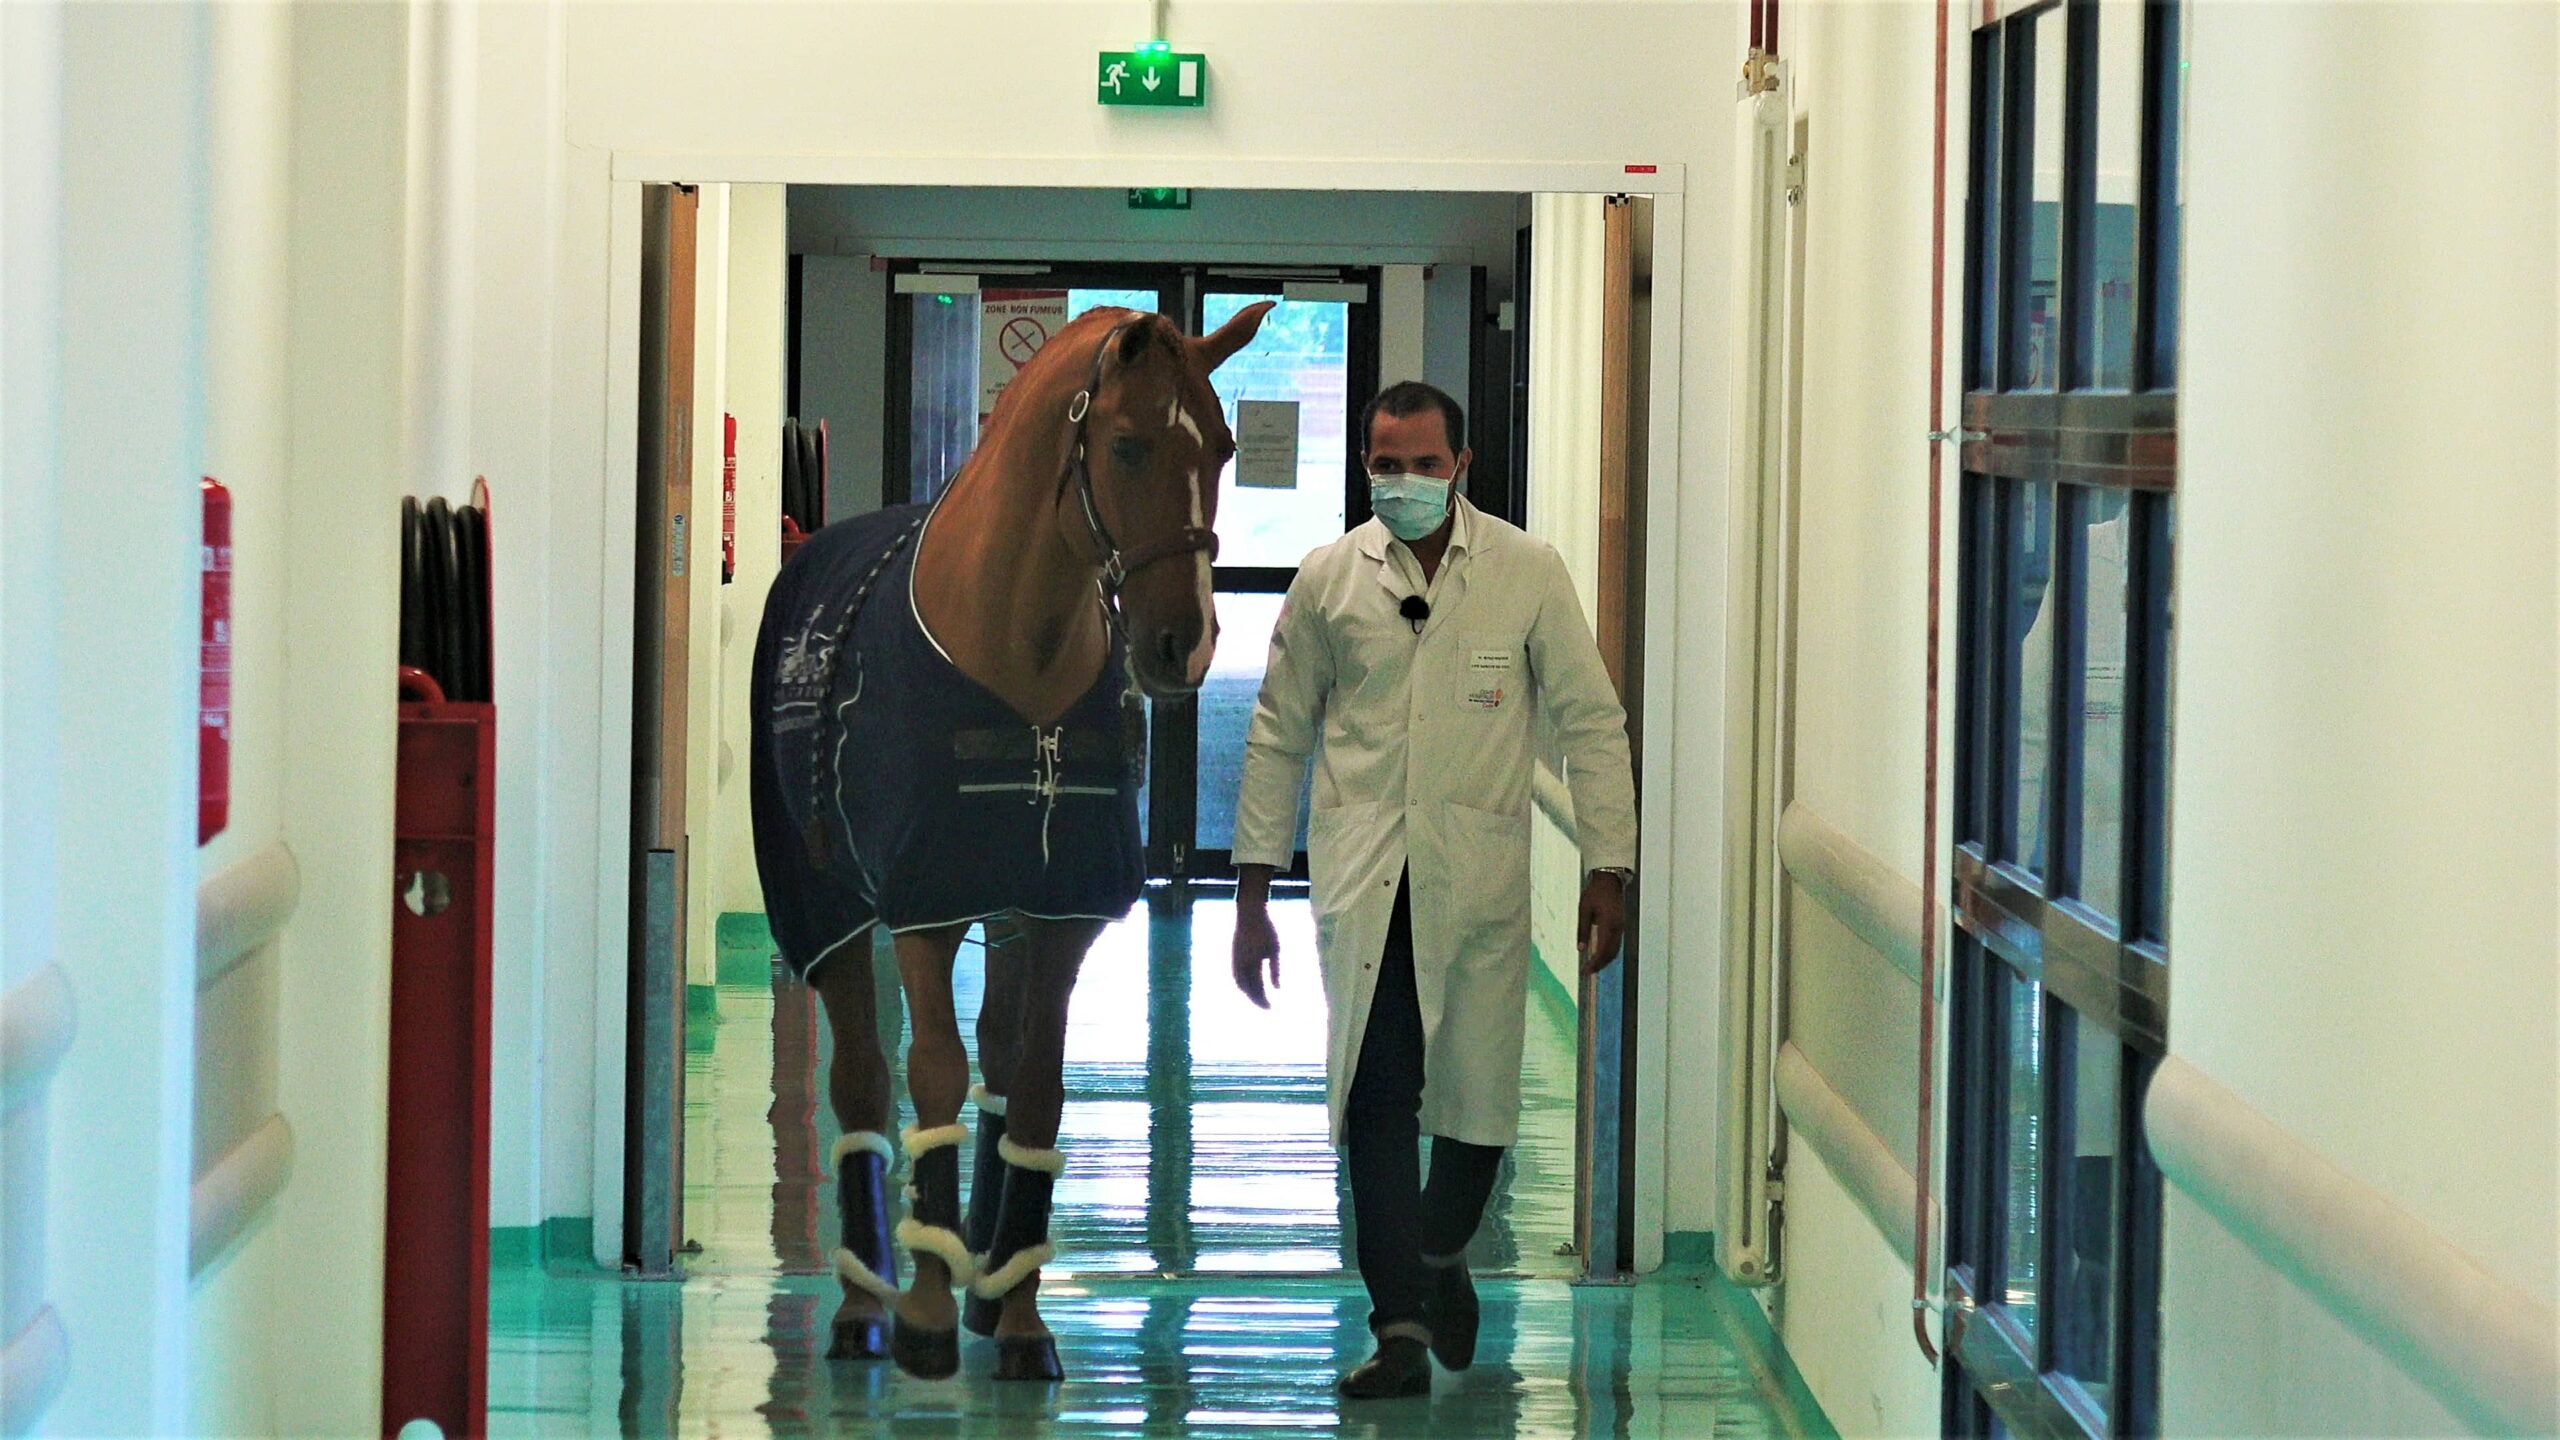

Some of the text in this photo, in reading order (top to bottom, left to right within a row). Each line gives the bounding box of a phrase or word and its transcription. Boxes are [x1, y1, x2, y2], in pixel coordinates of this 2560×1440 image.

[985, 304, 1063, 315] ZONE NON FUMEUR
